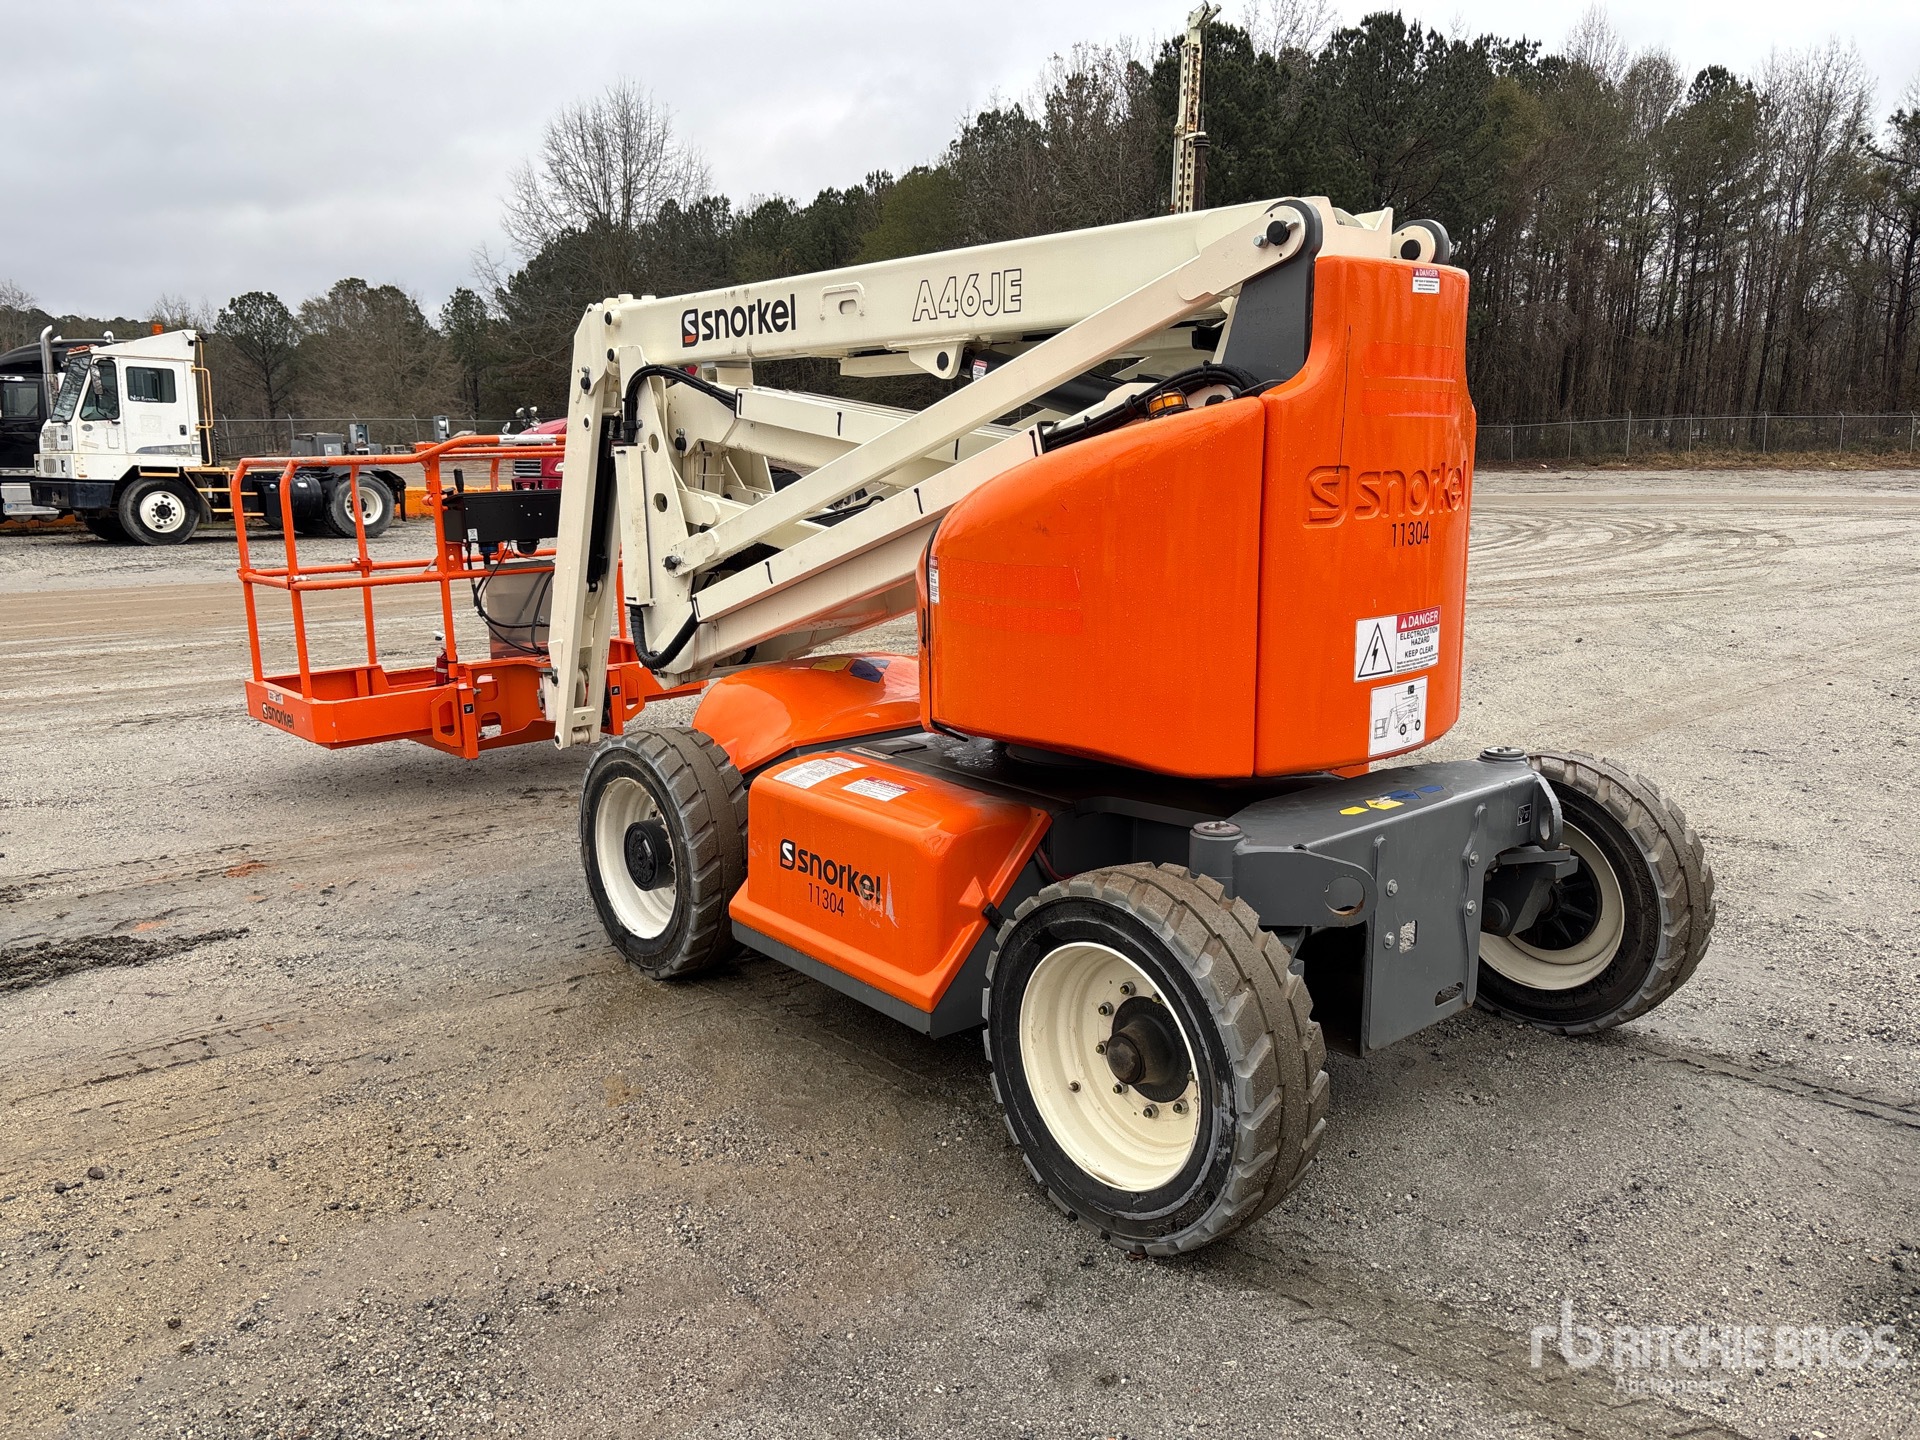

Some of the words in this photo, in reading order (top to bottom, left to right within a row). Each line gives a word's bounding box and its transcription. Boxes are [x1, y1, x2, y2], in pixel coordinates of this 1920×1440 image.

[1419, 269, 1439, 277] DANGER
[912, 268, 1022, 322] A46JE
[701, 293, 796, 341] snorkel
[1355, 460, 1467, 519] snorkel
[1392, 521, 1429, 547] 11304
[1408, 610, 1439, 628] DANGER
[1400, 626, 1438, 640] ELECTROCUTION
[1411, 636, 1430, 646] HAZARD
[1404, 649, 1418, 658] KEEP
[1419, 645, 1434, 655] CLEAR
[267, 706, 294, 730] snorkel
[797, 848, 881, 905] snorkel
[808, 882, 845, 917] 11304
